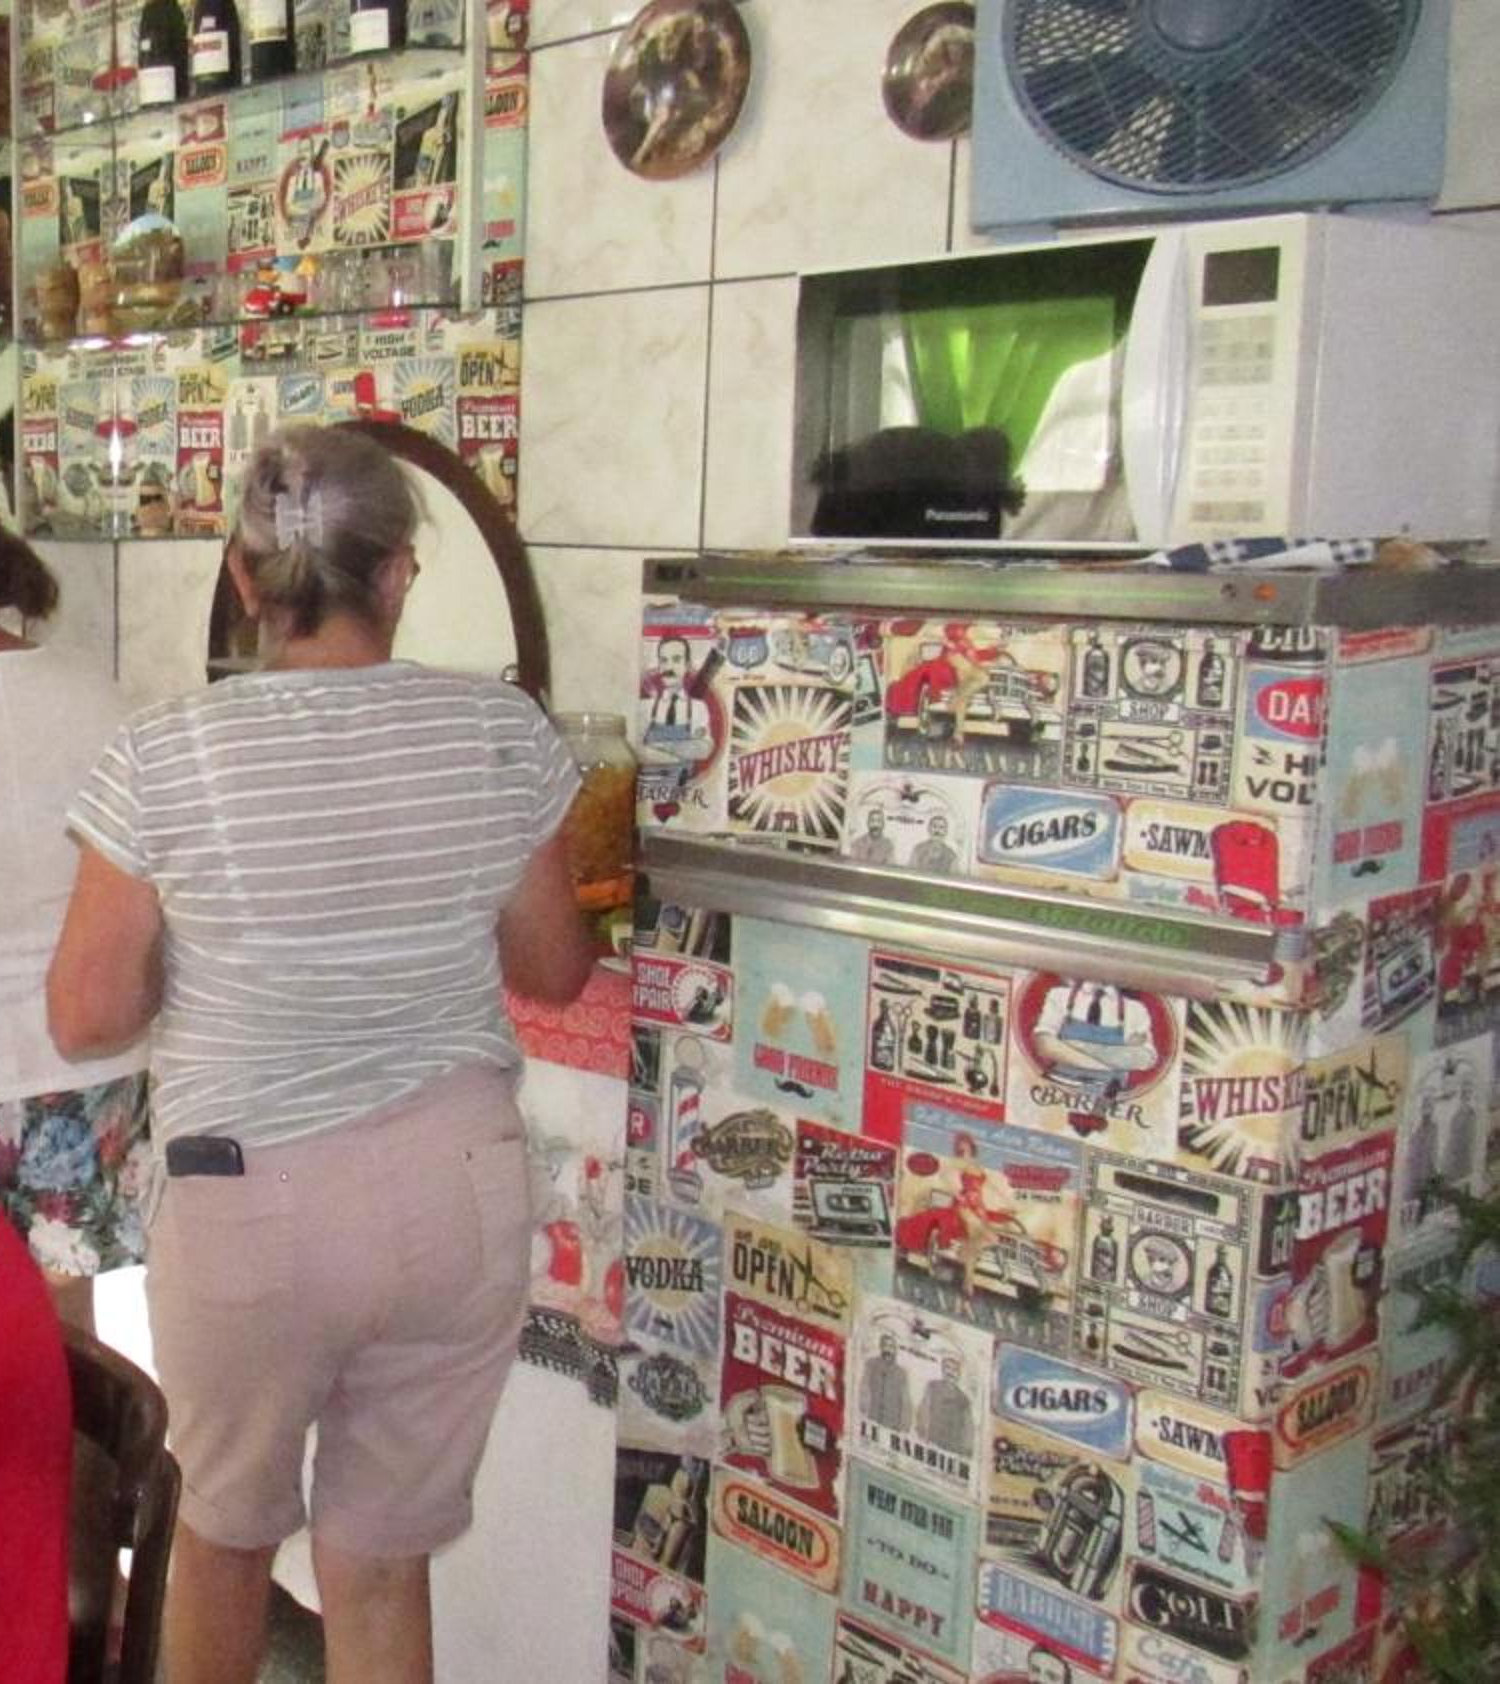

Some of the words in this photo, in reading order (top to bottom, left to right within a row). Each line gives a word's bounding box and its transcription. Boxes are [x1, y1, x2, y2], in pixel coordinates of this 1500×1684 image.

[181, 427, 221, 448] BEER
[461, 415, 518, 439] BEER
[925, 509, 989, 521] Panasonic
[738, 732, 846, 792] WHISKEY
[1000, 810, 1098, 851] CIGARS
[1297, 1166, 1388, 1242] BEER
[625, 1254, 704, 1293] VODKA
[732, 1242, 795, 1301] OPEN
[733, 1322, 837, 1401] BEER
[1012, 1385, 1109, 1415] CIGARS
[736, 1494, 816, 1559] SALOON
